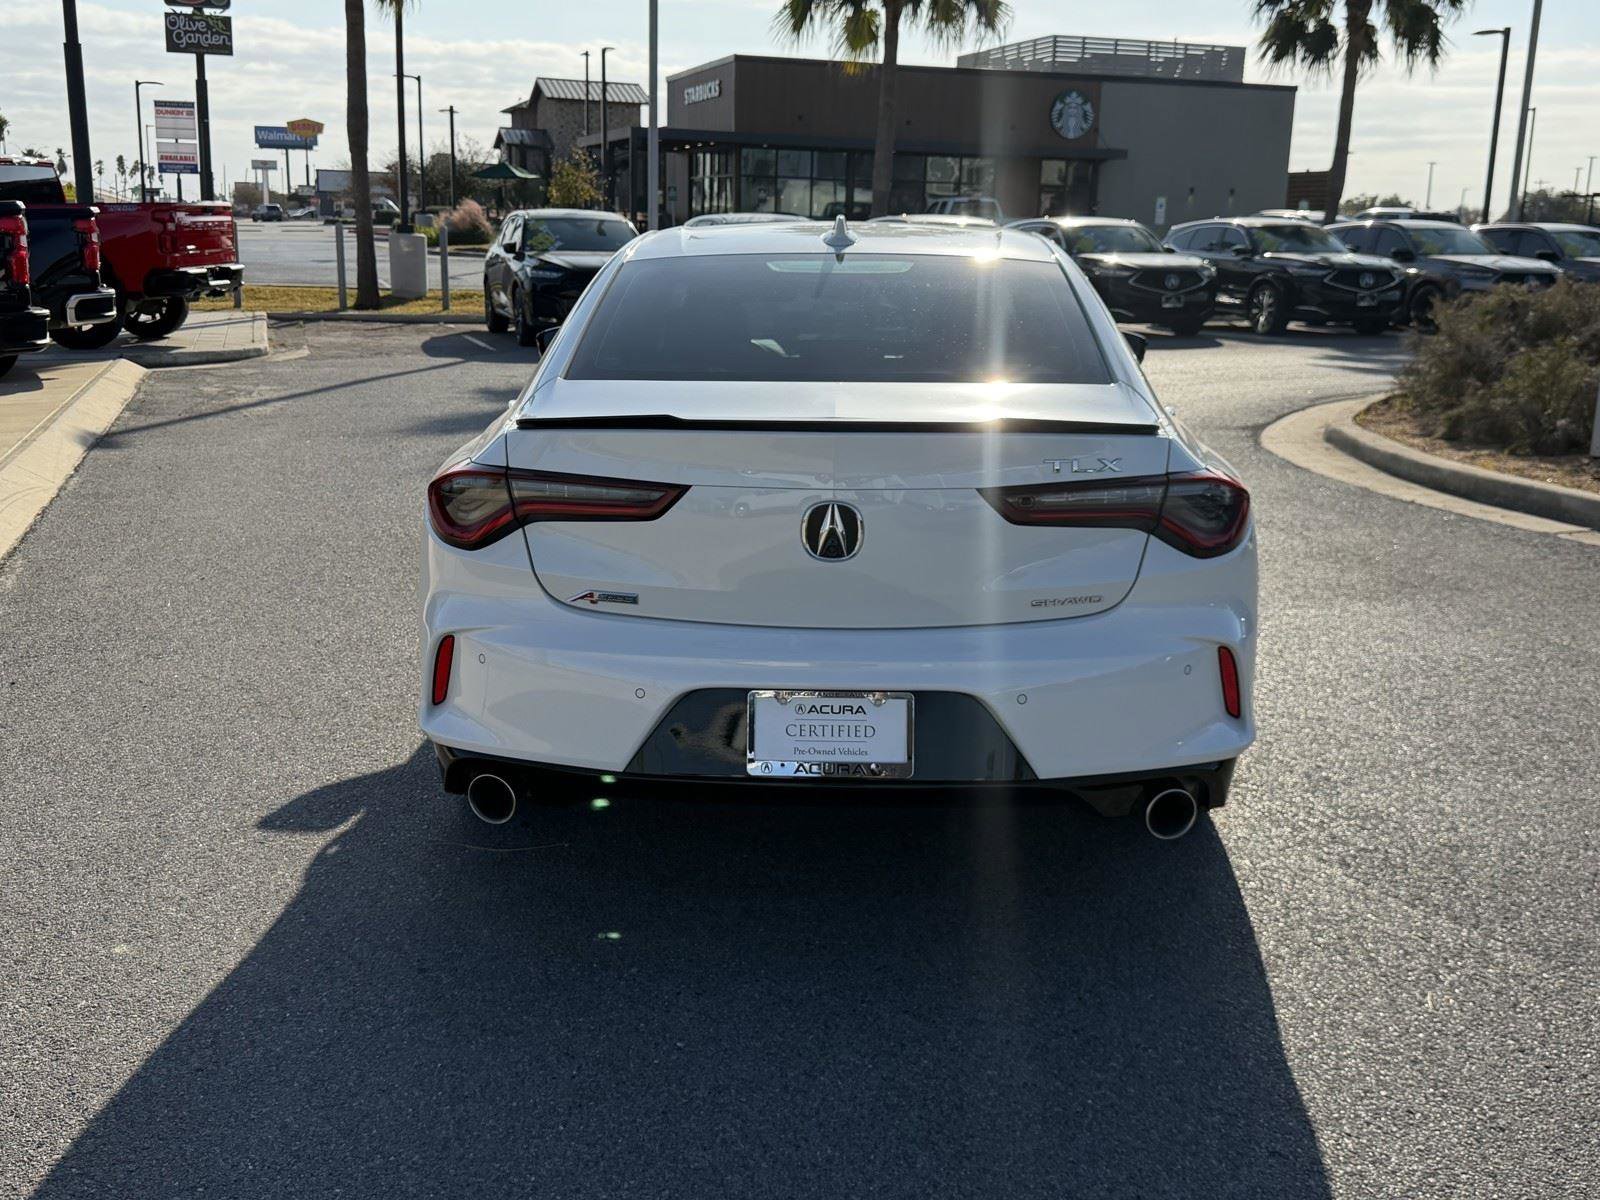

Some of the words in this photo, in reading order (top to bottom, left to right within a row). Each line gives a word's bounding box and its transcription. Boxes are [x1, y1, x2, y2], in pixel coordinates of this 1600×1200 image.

[166, 15, 207, 31] Olive
[172, 29, 231, 48] Garden
[684, 79, 720, 105] STARBUCKS
[1043, 458, 1122, 473] TLX
[807, 704, 867, 715] ACURA
[785, 724, 876, 738] CERTIFIED
[793, 747, 836, 756] Pre-Owned
[837, 747, 869, 756] Vehicles
[793, 763, 866, 775] ACURA
